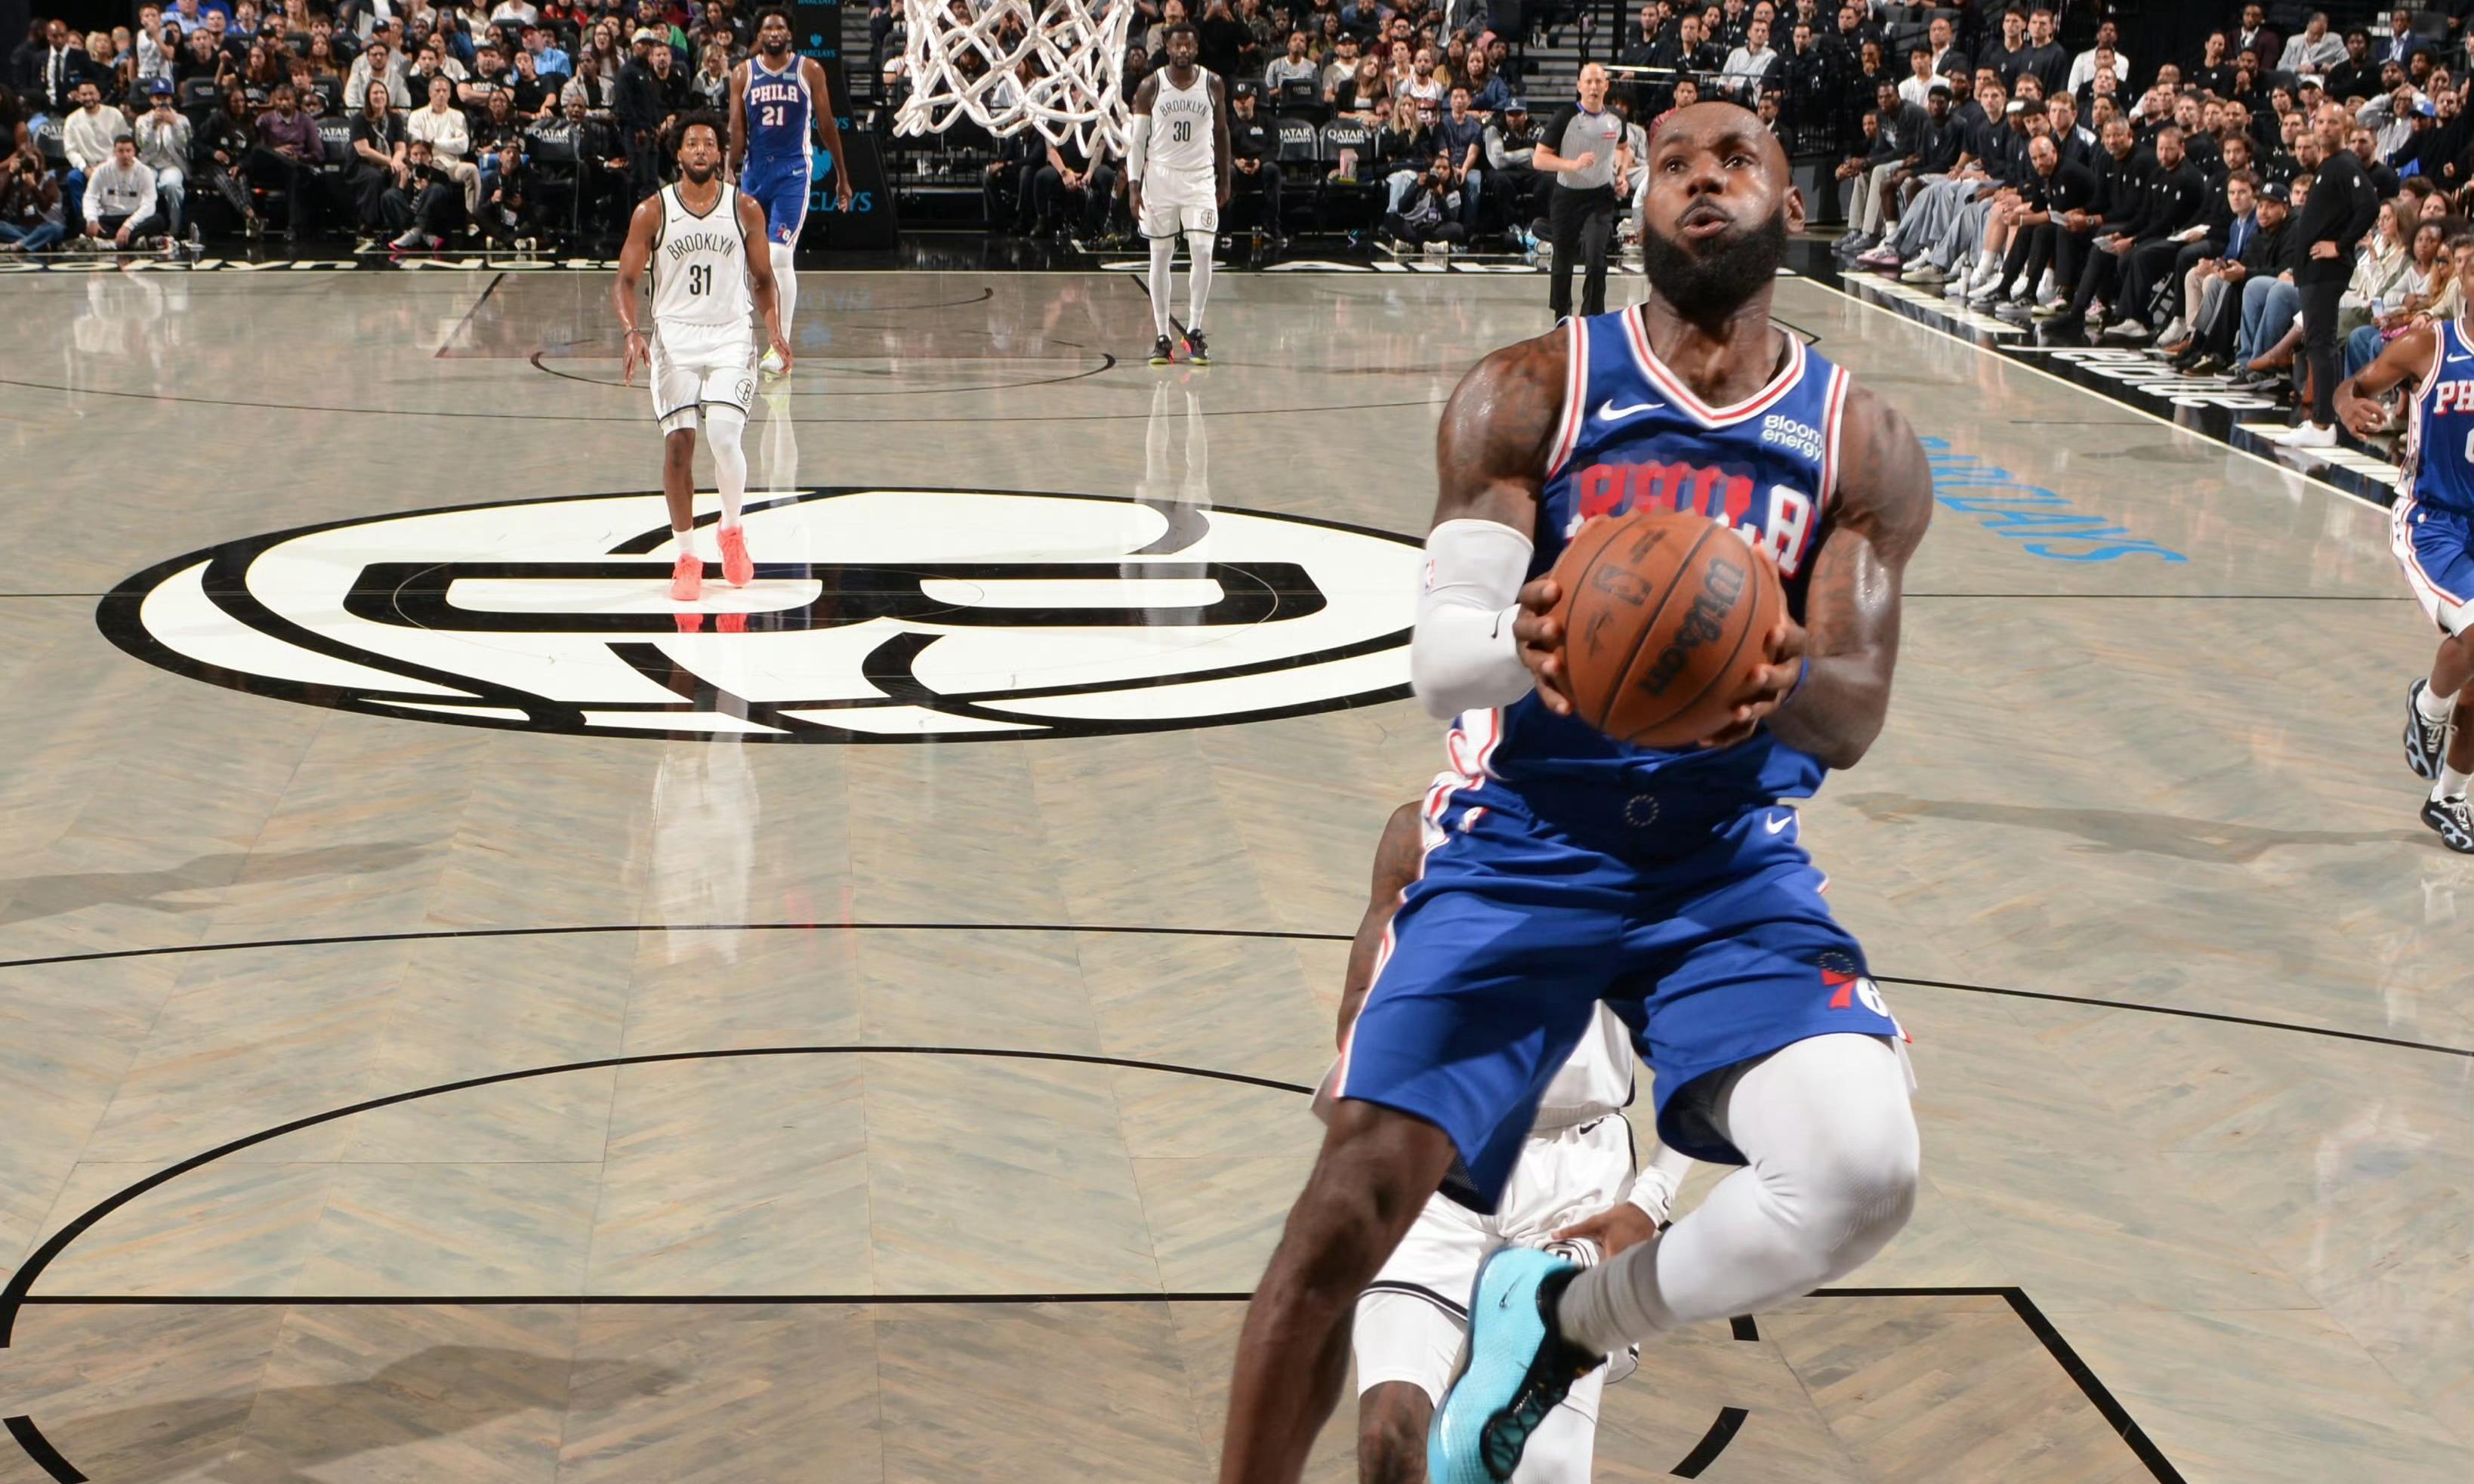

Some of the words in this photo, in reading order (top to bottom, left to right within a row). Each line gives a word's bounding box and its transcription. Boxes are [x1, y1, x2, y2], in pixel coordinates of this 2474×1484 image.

[797, 49, 836, 57] BARCLAYS
[751, 84, 799, 106] PHILA
[761, 106, 784, 126] 21
[1159, 100, 1209, 117] BROOKLYN
[532, 128, 569, 139] QATAR
[1173, 121, 1191, 142] 30
[1279, 128, 1310, 139] ATAR
[1328, 128, 1365, 140] QATAR
[667, 233, 736, 261] BROOKLYN
[689, 264, 711, 296] 31
[1764, 415, 1823, 447] Bloom
[1762, 429, 1822, 461] energy
[1638, 557, 1746, 697] Wilson
[1821, 967, 1889, 1017] 76
